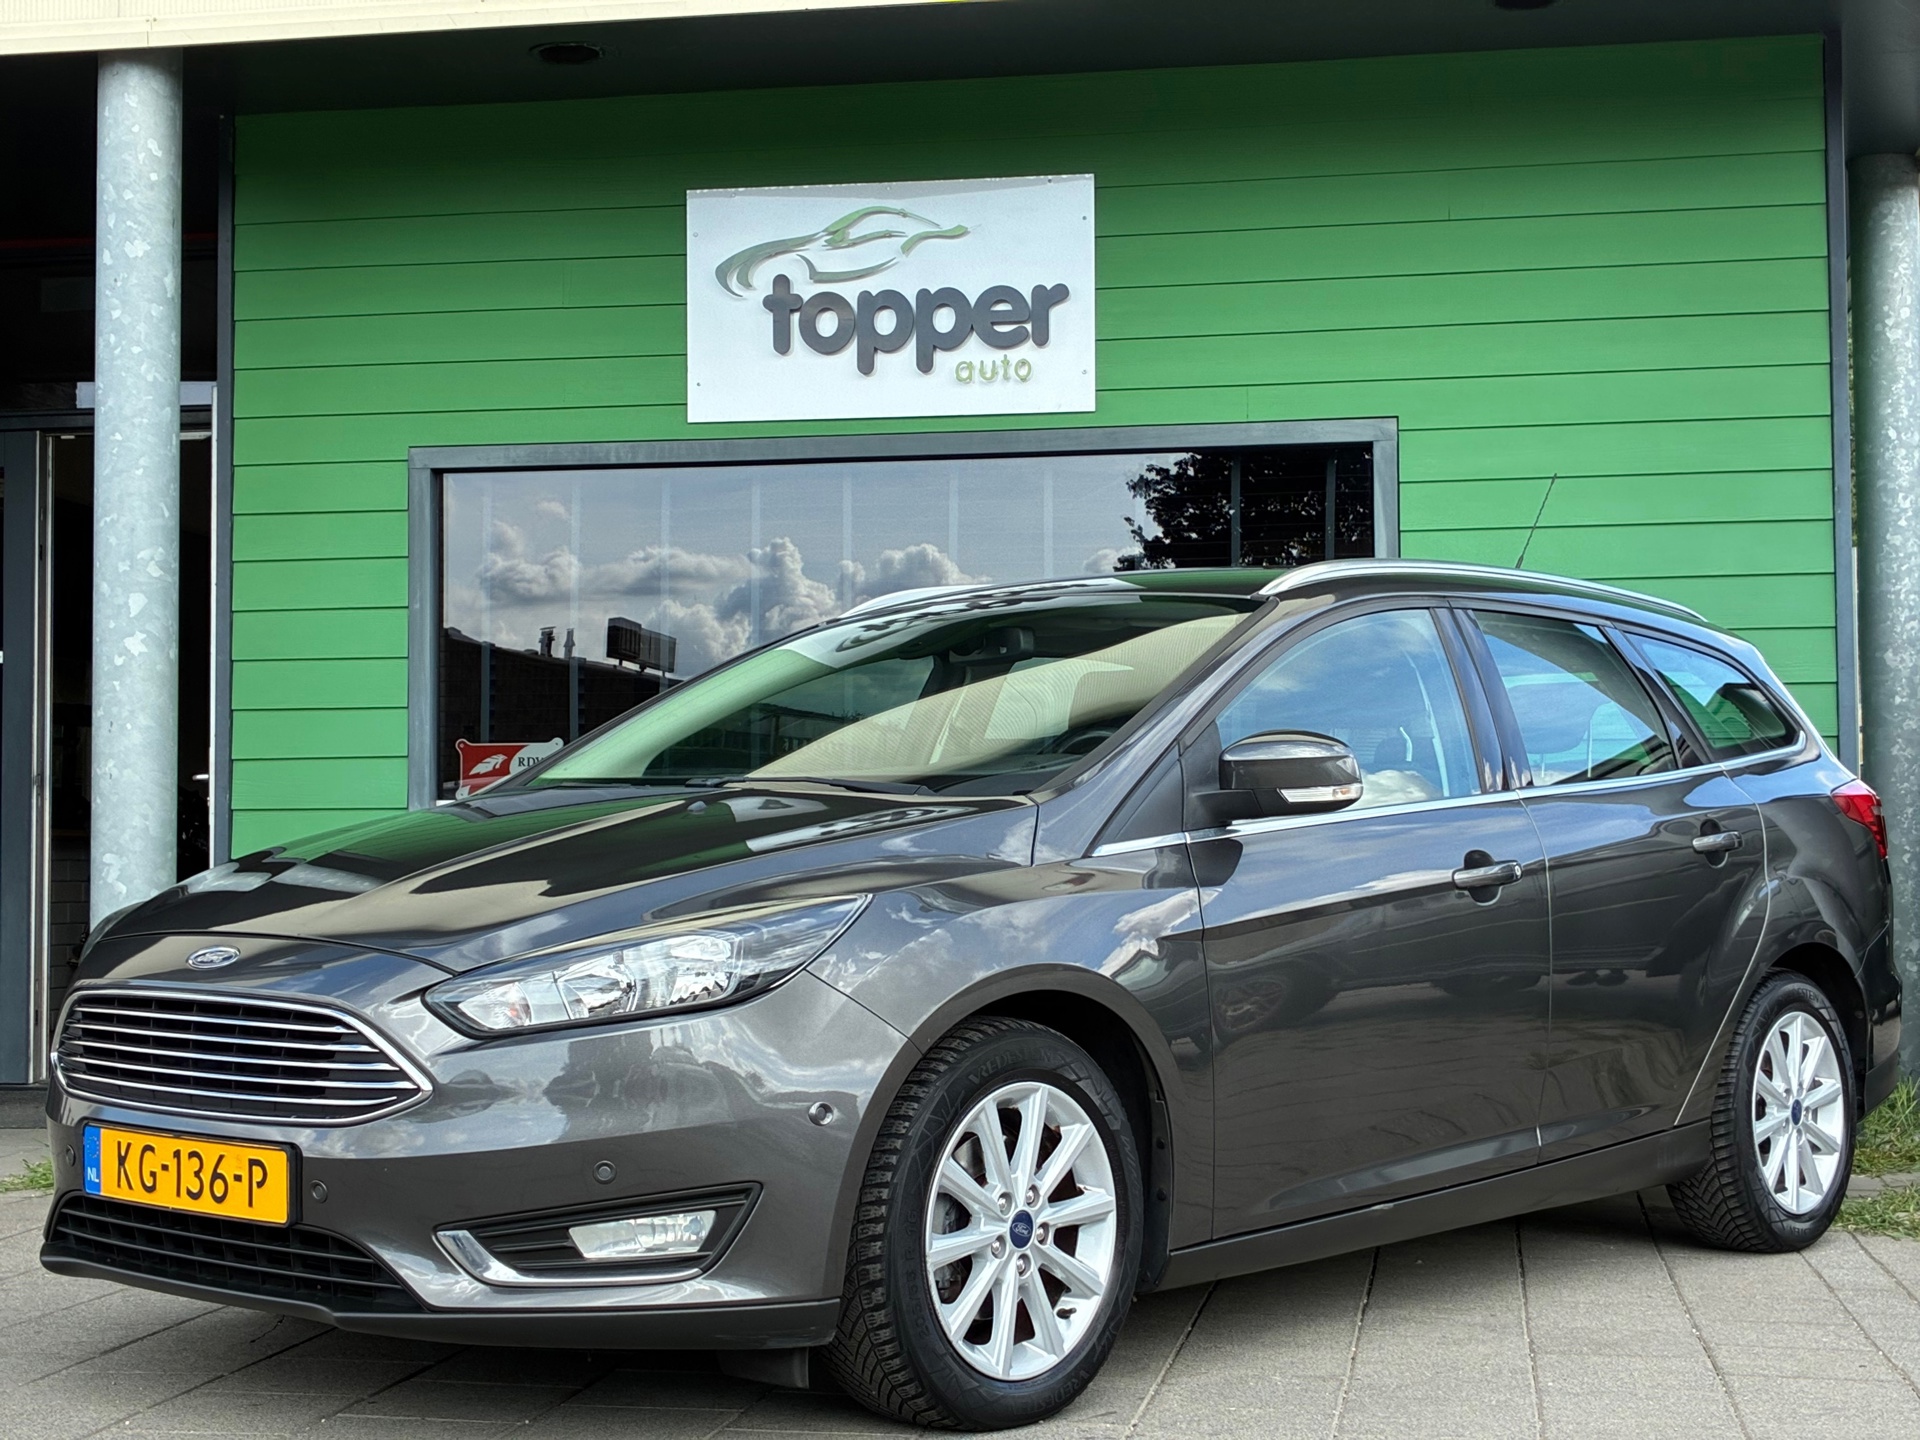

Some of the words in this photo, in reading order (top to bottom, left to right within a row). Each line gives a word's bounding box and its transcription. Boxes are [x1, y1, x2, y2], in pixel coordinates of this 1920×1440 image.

[762, 273, 1070, 376] topper
[954, 354, 1033, 383] auto
[517, 757, 545, 768] RD
[87, 1167, 100, 1183] NL
[116, 1140, 268, 1209] KG-136-P
